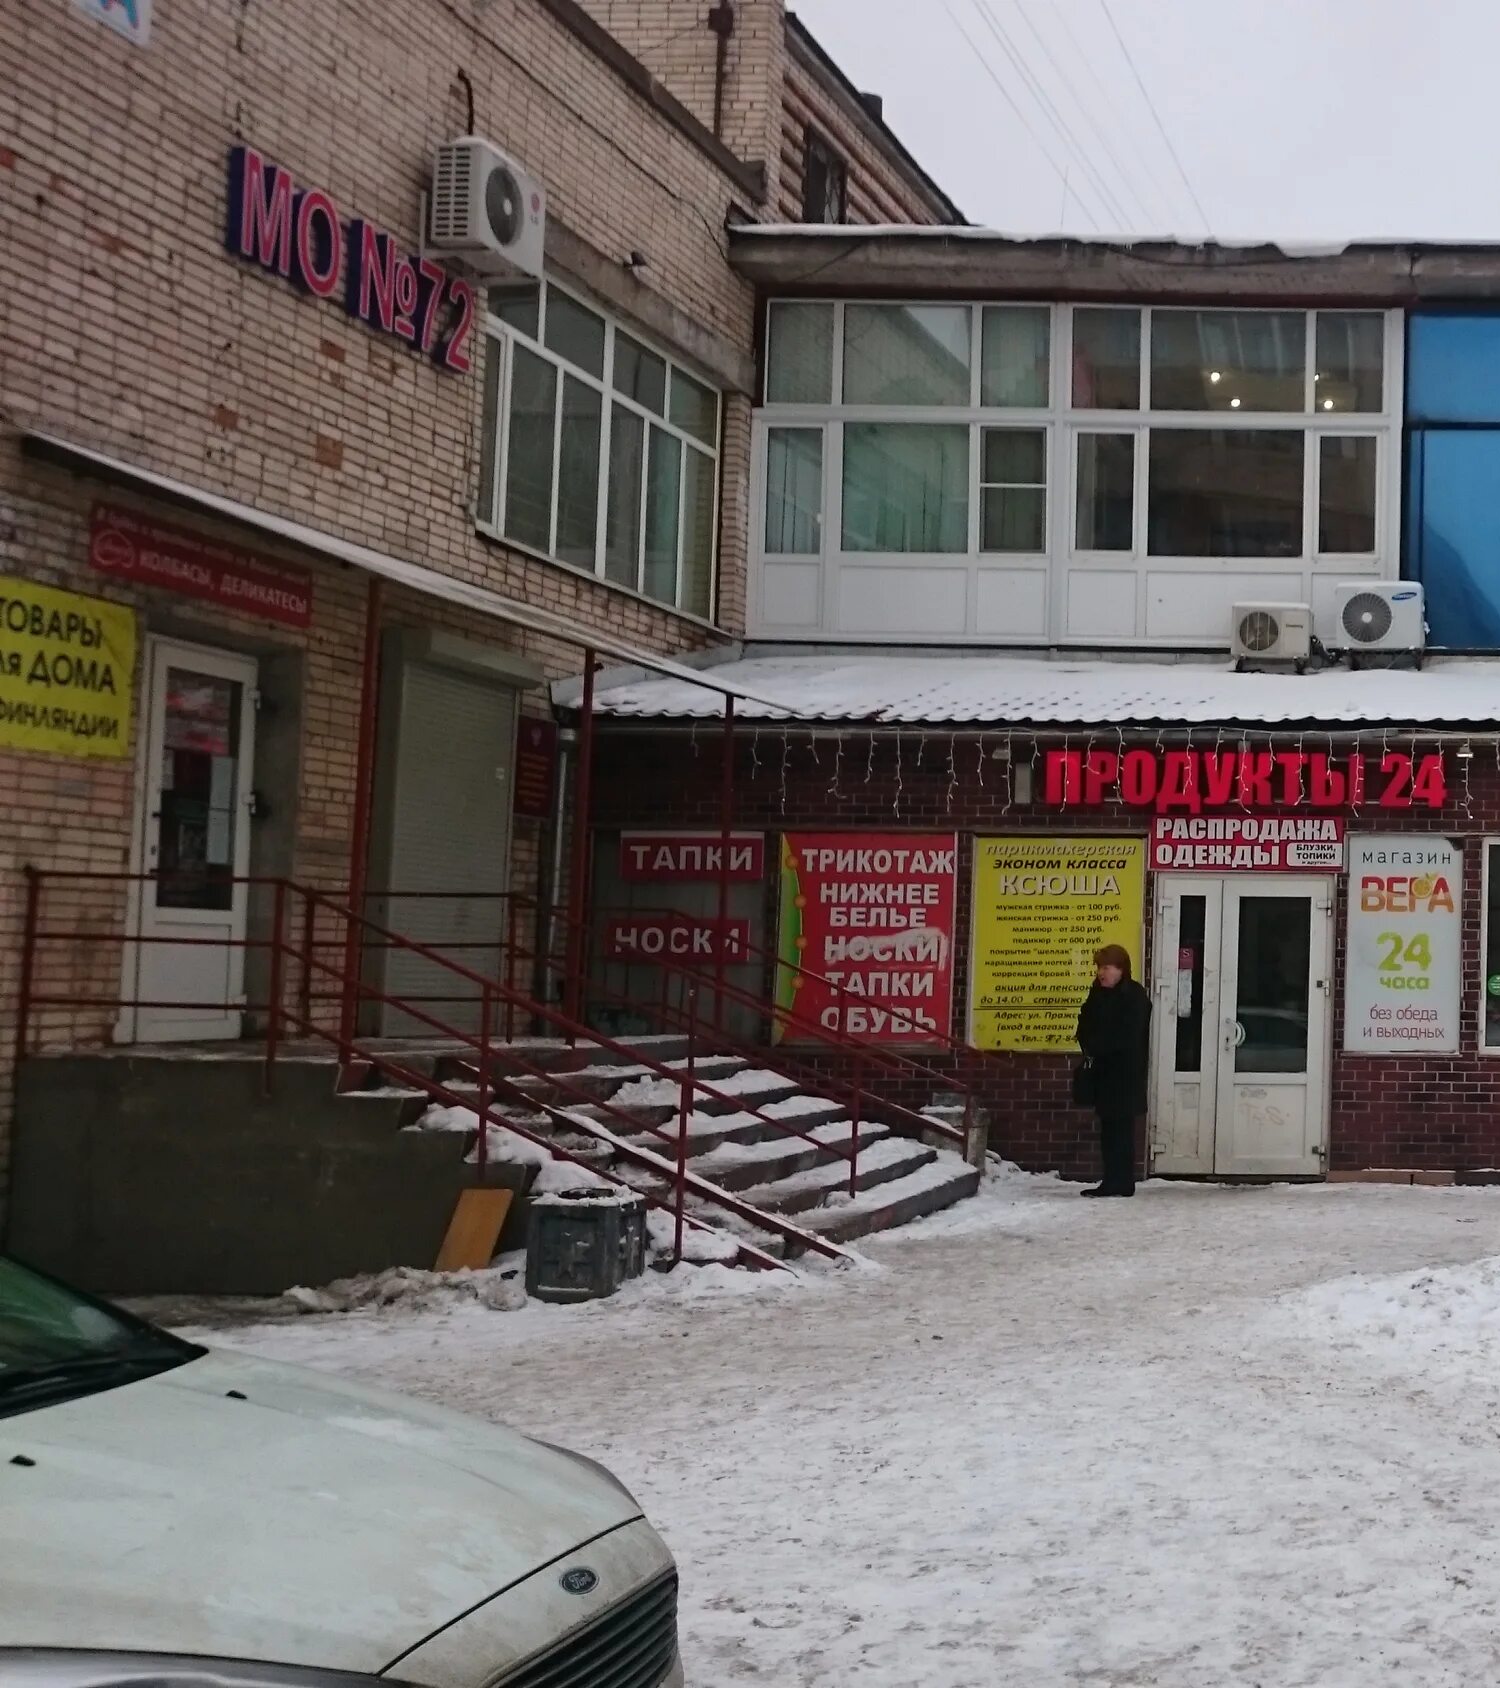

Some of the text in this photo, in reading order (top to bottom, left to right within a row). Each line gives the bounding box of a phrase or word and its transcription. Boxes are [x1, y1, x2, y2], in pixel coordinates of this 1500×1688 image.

[238, 148, 476, 373] МО №72
[27, 650, 117, 696] ДОМА
[1046, 751, 1448, 813] ПРОДУКТЫ 24
[1156, 818, 1338, 843] РАСПРОДАЖА
[630, 845, 753, 871] ТАПКИ
[986, 844, 1137, 857] парикмахерская
[1156, 843, 1280, 868] ОДЕЖДЫ
[1296, 844, 1336, 852] БЛУЗКИ,
[1362, 851, 1451, 864] магазин
[802, 849, 954, 874] ТРИКОТАЖ
[993, 859, 1127, 869] эконом класса
[820, 883, 940, 905] НИЖНЕЕ
[1001, 875, 1121, 896] КСЮША
[1360, 876, 1455, 913] ВЕРА
[830, 907, 927, 928] БЕЛЬЕ
[824, 935, 938, 962] НОСКИ
[1376, 931, 1432, 971] 24
[824, 972, 934, 997] ТАПКИ
[995, 985, 1026, 994] акция
[1028, 983, 1047, 992] для
[1379, 975, 1430, 990] часа
[820, 1006, 937, 1034] ОБУВЬ
[994, 1012, 1026, 1021] Адрес:
[1369, 1004, 1438, 1022] без обеда
[1376, 1027, 1445, 1040] выходных
